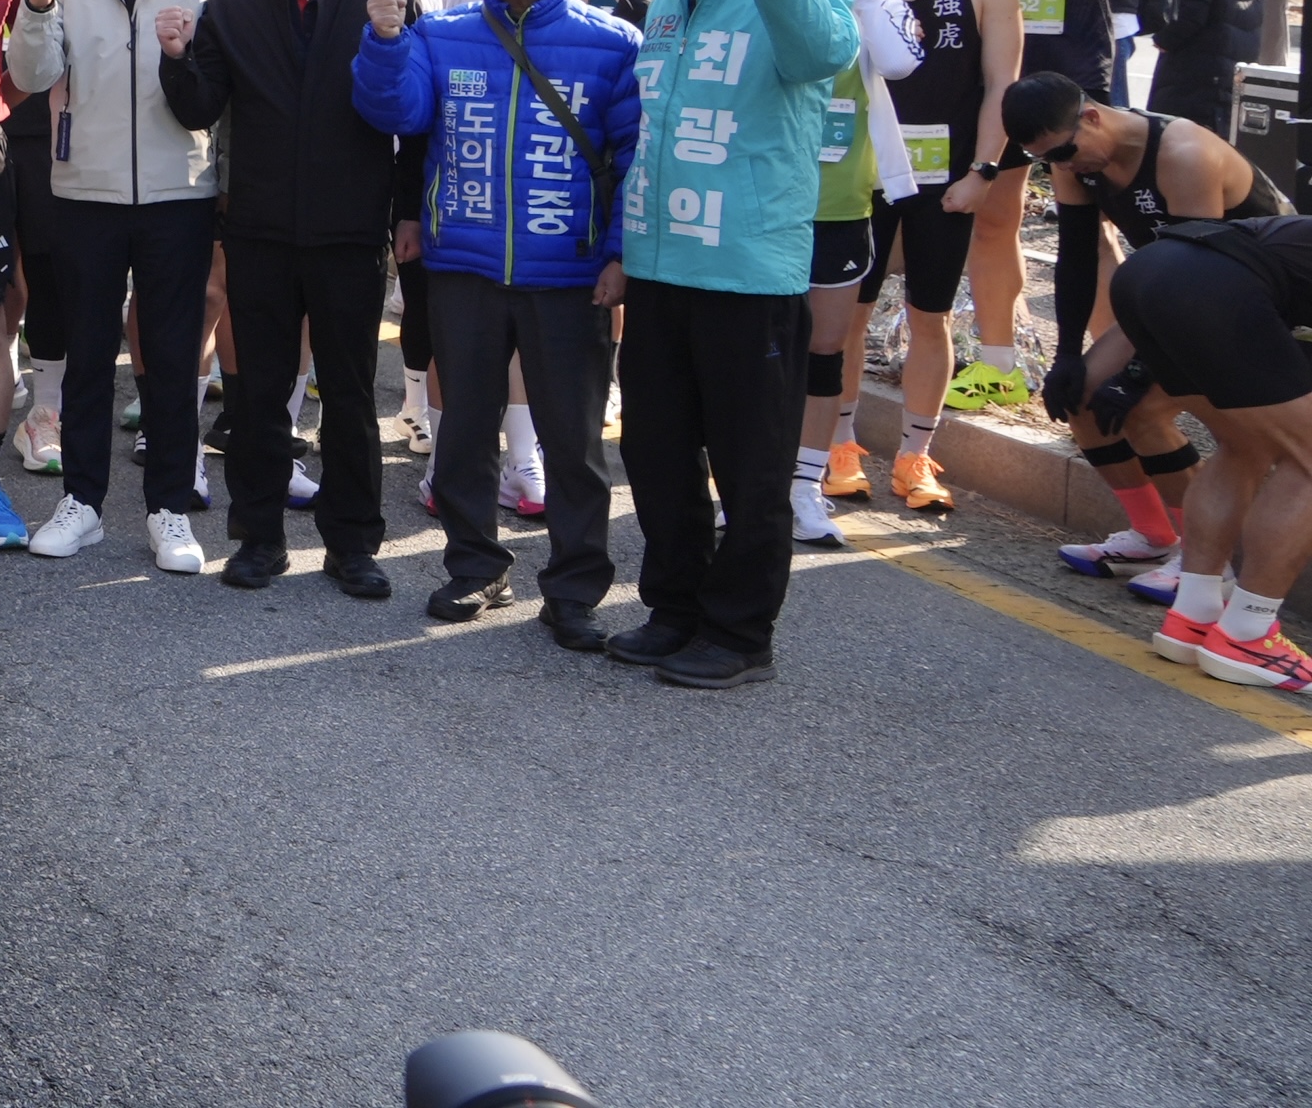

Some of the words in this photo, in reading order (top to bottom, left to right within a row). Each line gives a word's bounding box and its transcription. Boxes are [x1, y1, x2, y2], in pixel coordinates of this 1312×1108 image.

[450, 82, 487, 97] 민주당
[668, 30, 751, 247] 최광익
[458, 102, 496, 219] 도의원
